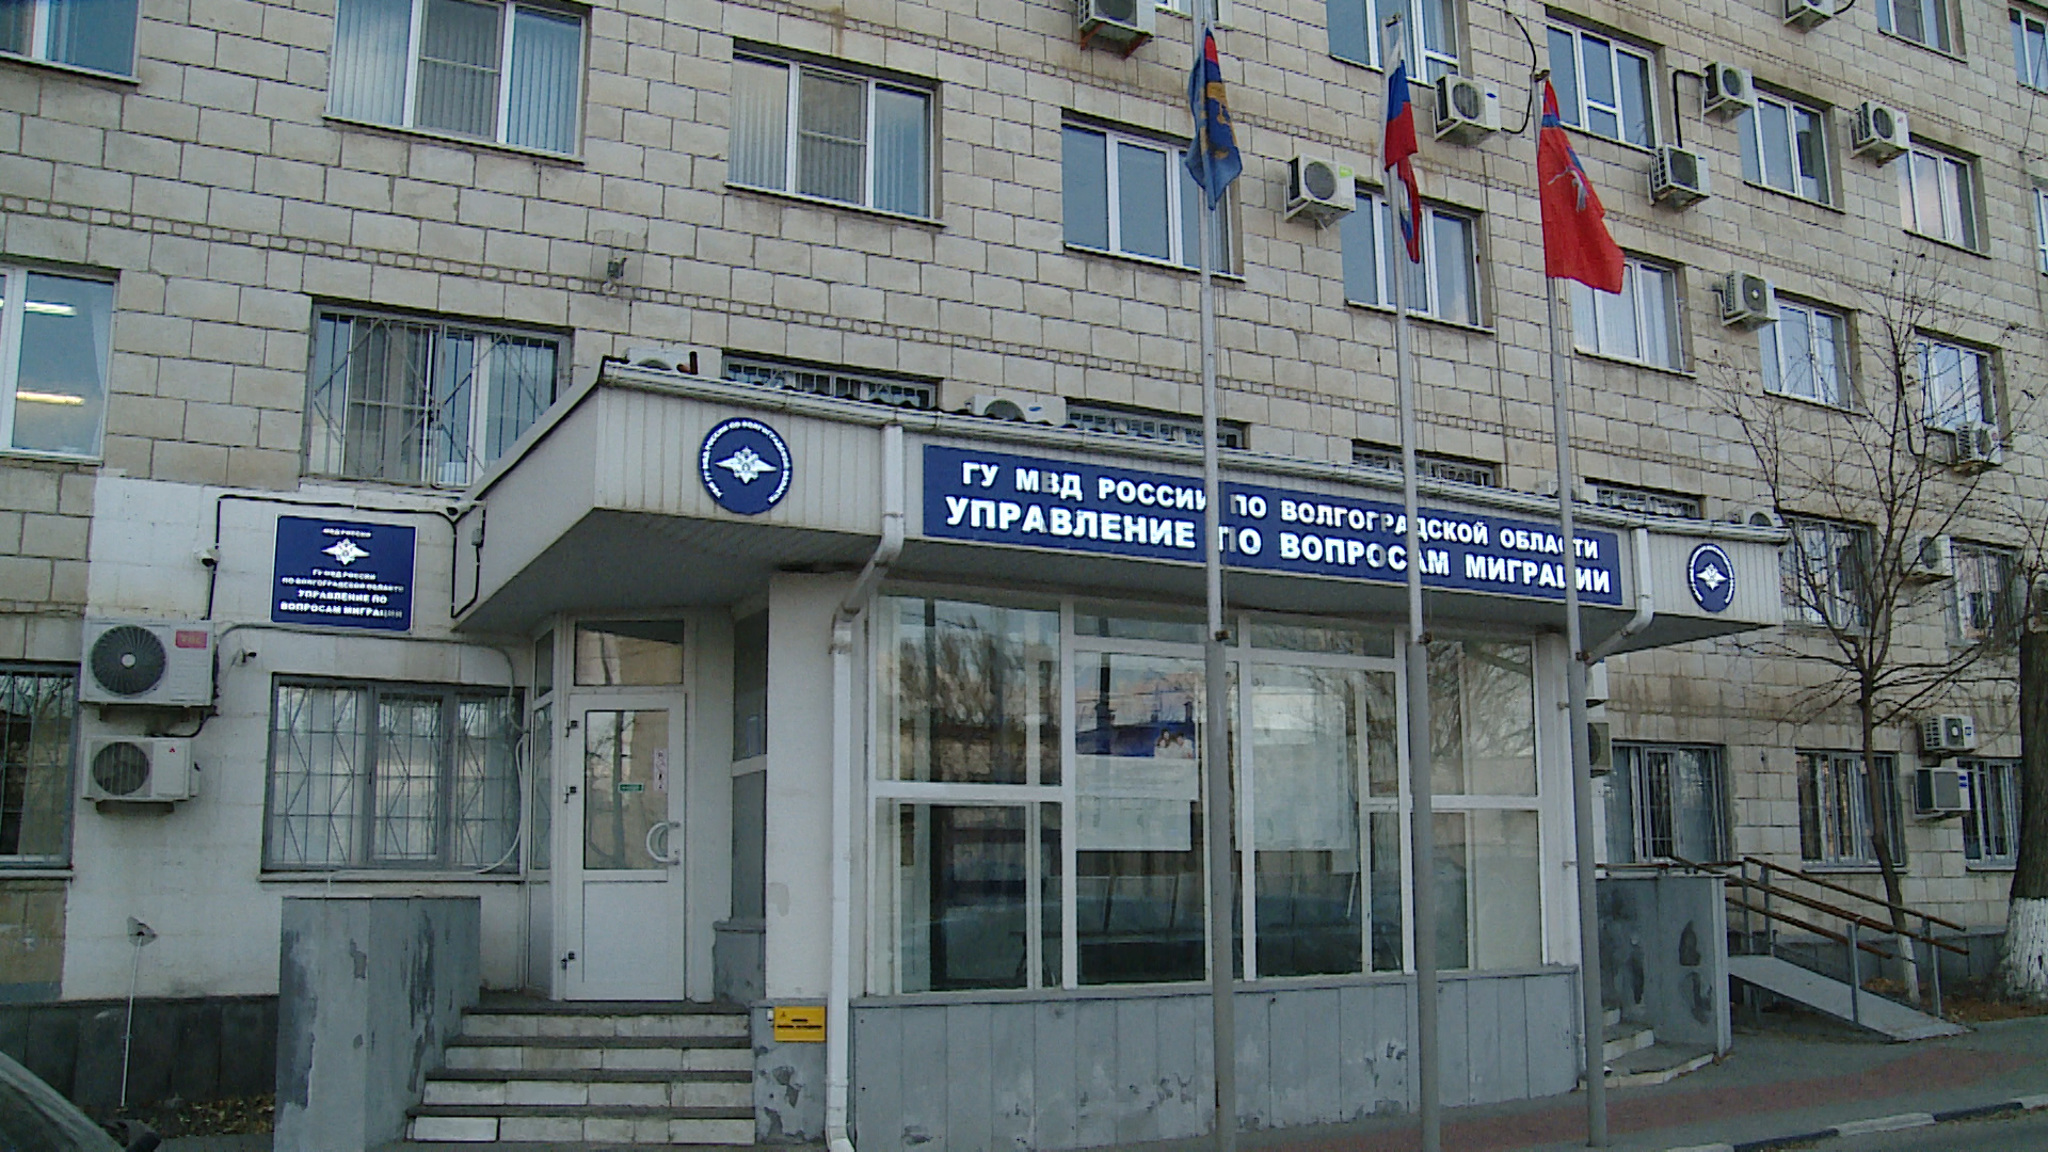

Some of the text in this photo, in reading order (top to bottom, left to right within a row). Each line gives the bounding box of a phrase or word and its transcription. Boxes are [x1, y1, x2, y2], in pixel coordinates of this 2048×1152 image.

[961, 461, 999, 487] ГУ
[1015, 467, 1083, 501] МВД
[1229, 494, 1267, 518] ПО
[945, 496, 1196, 548] УПРАВЛЕНИЕ
[1218, 526, 1262, 555] ПО
[280, 600, 342, 614] ВОПРОСАМ
[297, 588, 388, 604] УПРАВЛЕНИЕ ПО
